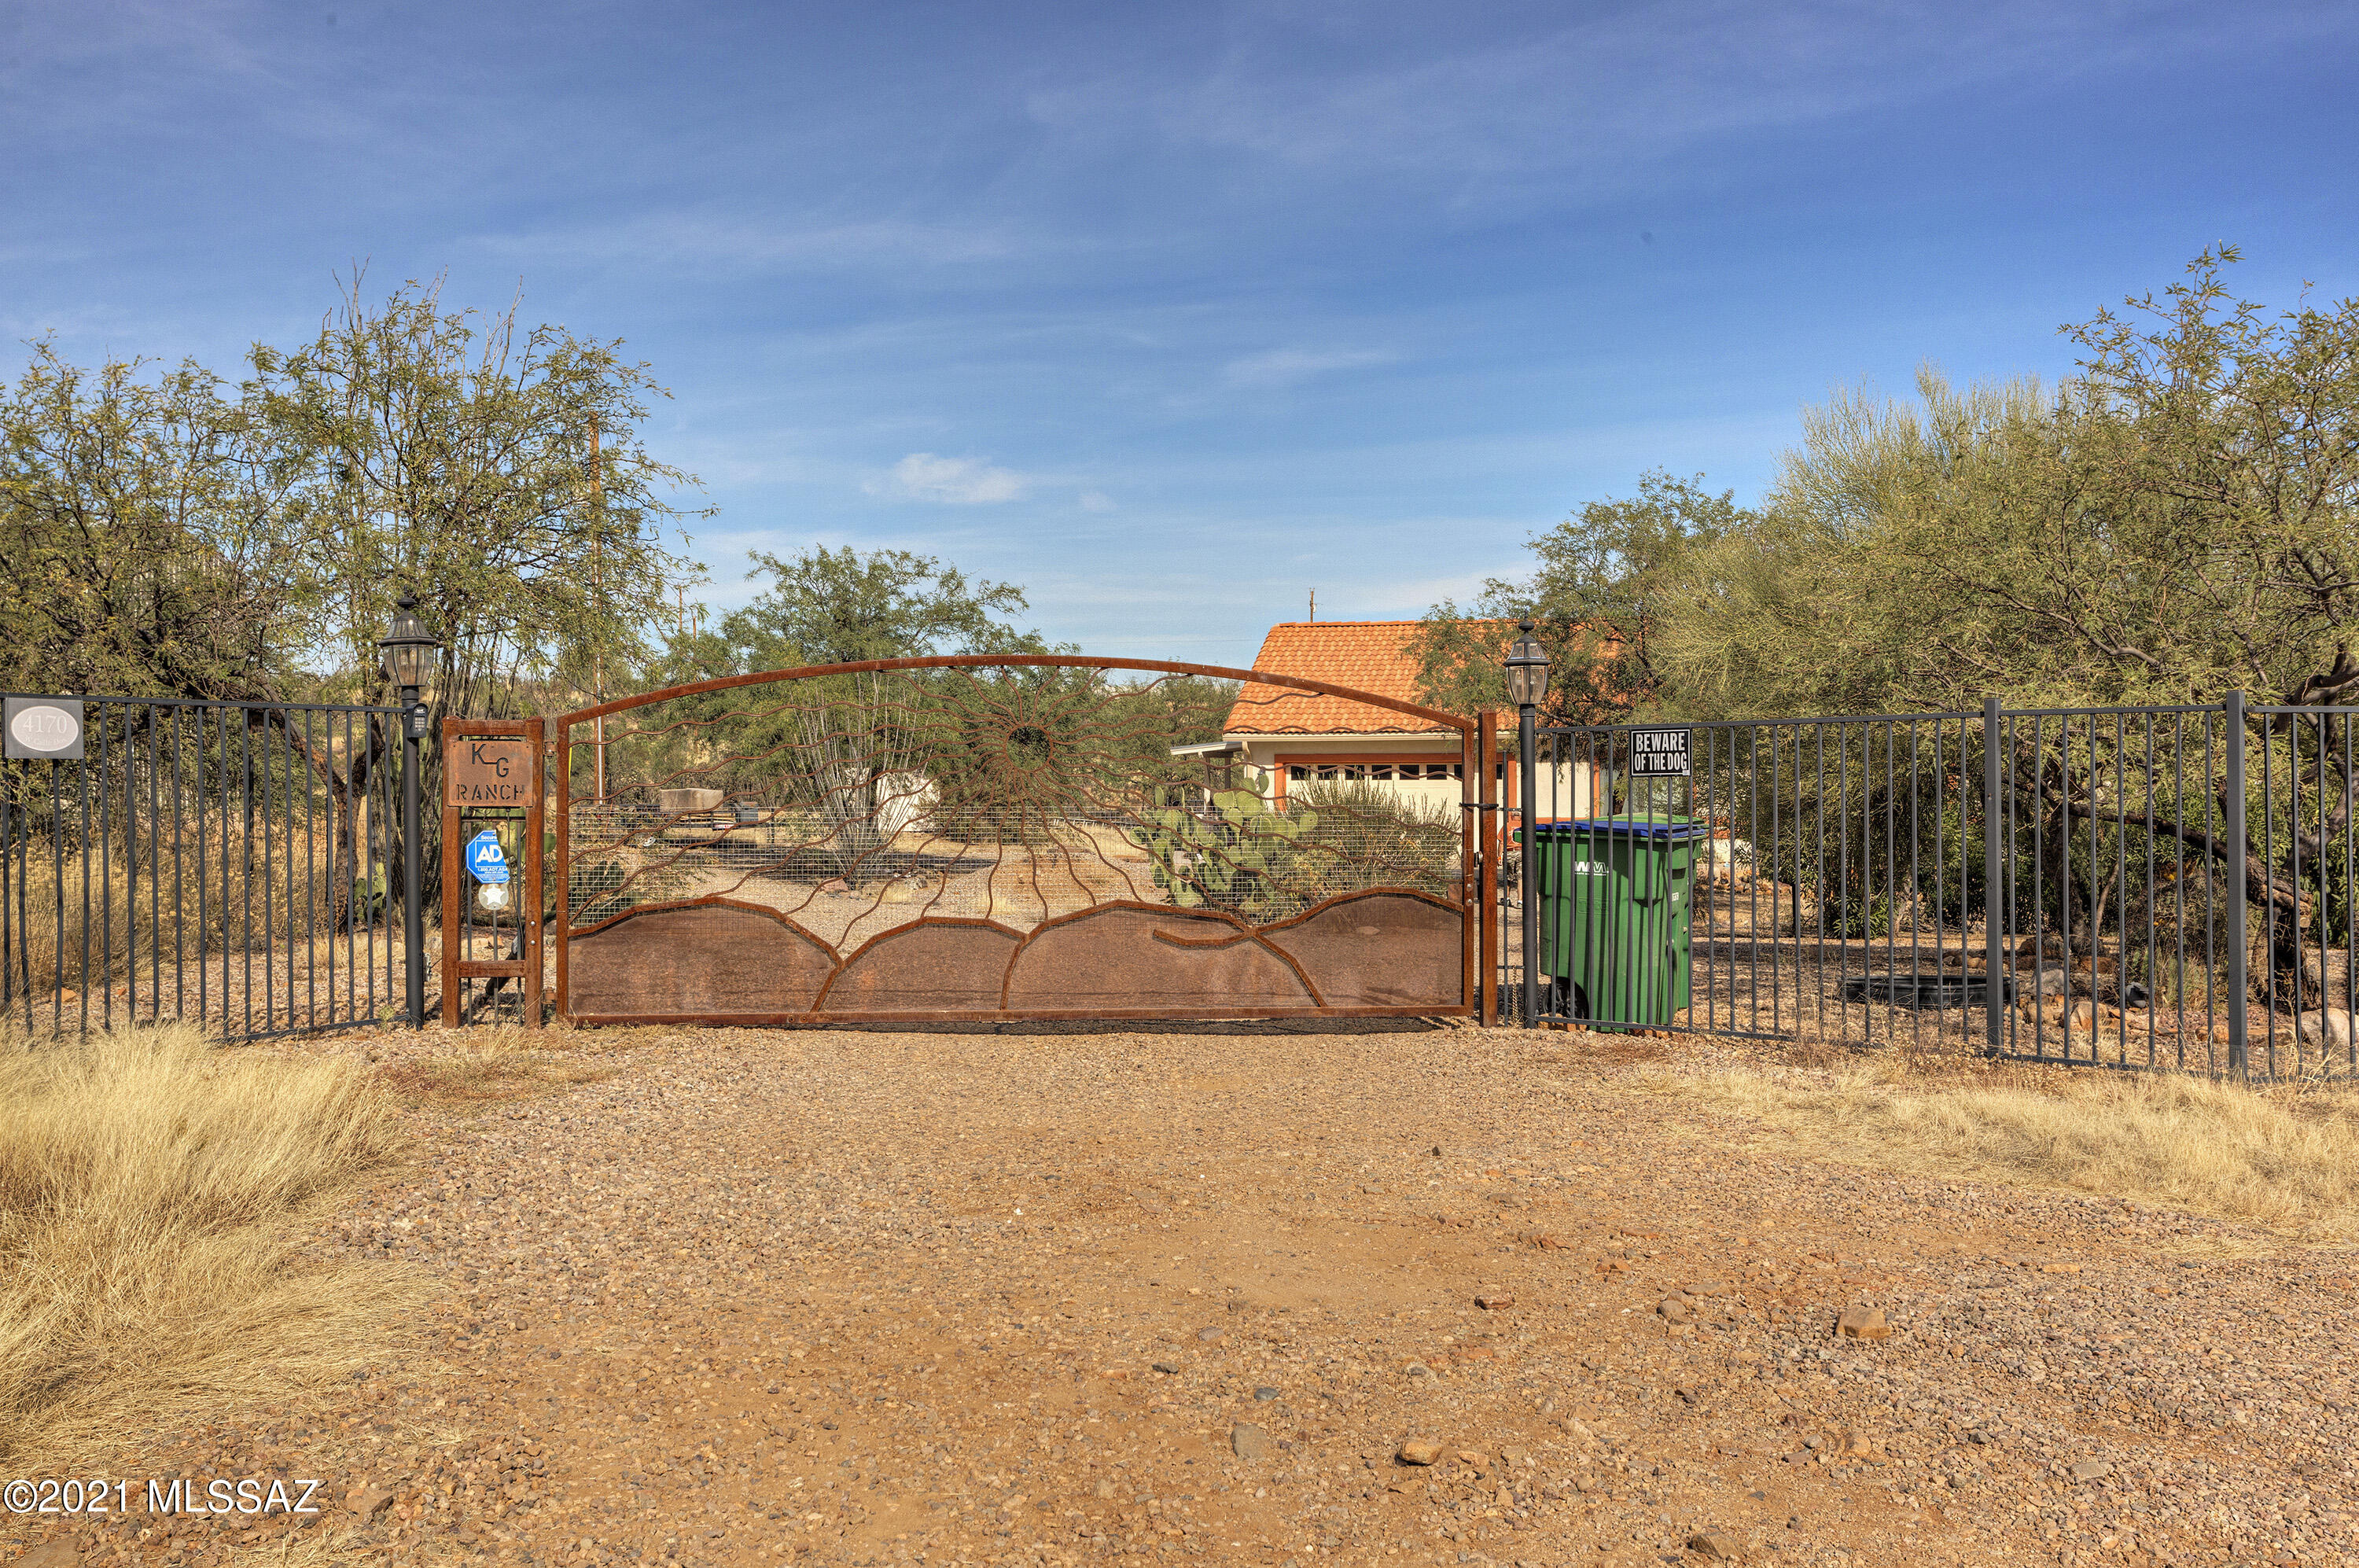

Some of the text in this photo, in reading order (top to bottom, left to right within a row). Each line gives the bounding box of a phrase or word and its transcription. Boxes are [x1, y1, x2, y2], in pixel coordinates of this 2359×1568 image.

[23, 714, 67, 734] 4170
[1636, 732, 1685, 752] BEWARE
[1634, 752, 1687, 771] OF THE DOG
[456, 784, 524, 801] RANCH
